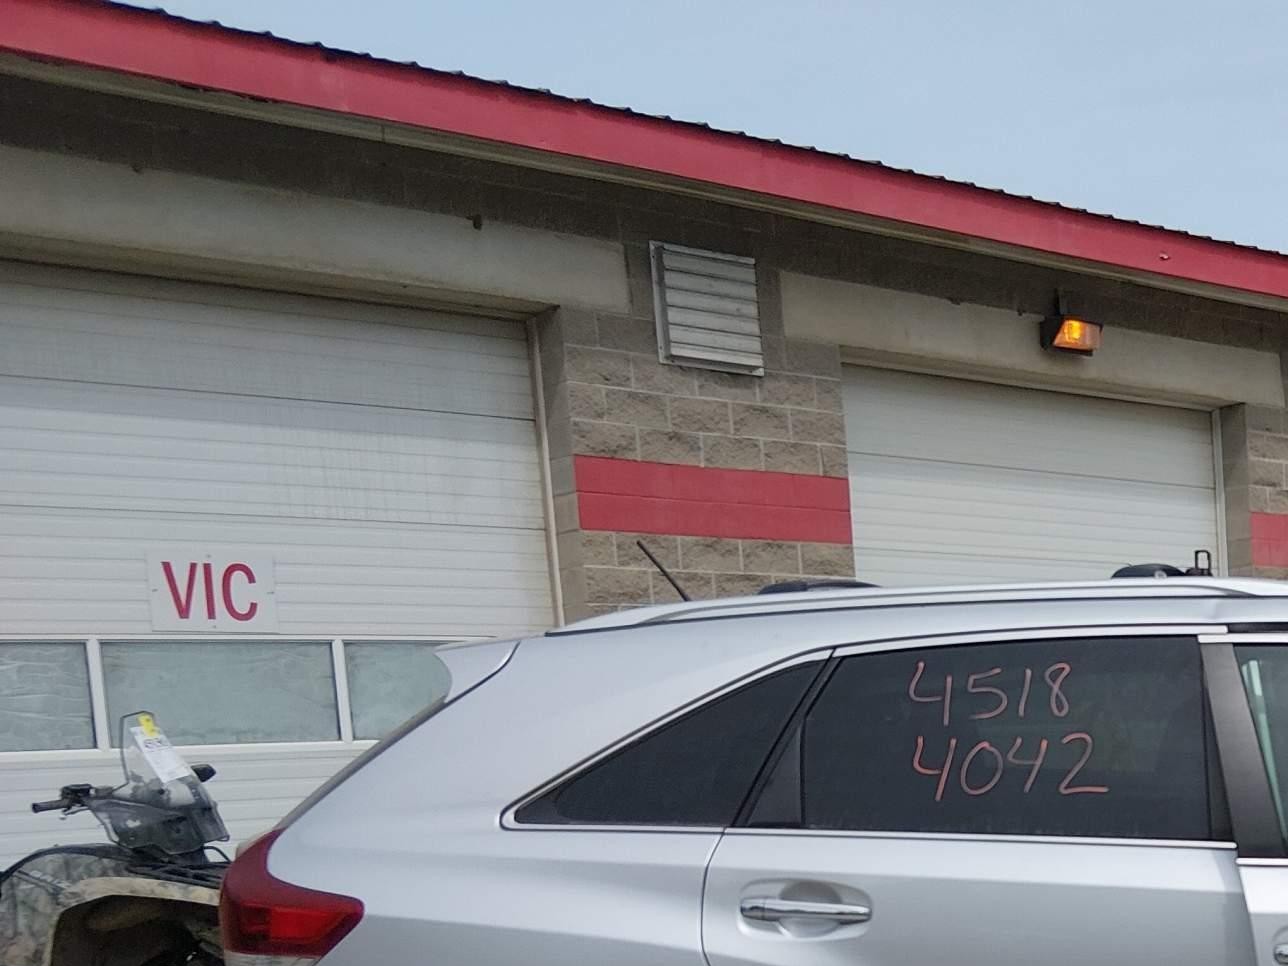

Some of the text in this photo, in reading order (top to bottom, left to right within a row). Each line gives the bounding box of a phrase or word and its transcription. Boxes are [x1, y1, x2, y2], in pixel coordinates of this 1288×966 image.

[160, 561, 258, 621] VIC
[908, 661, 1072, 726] 4518
[912, 732, 1110, 801] 4042
